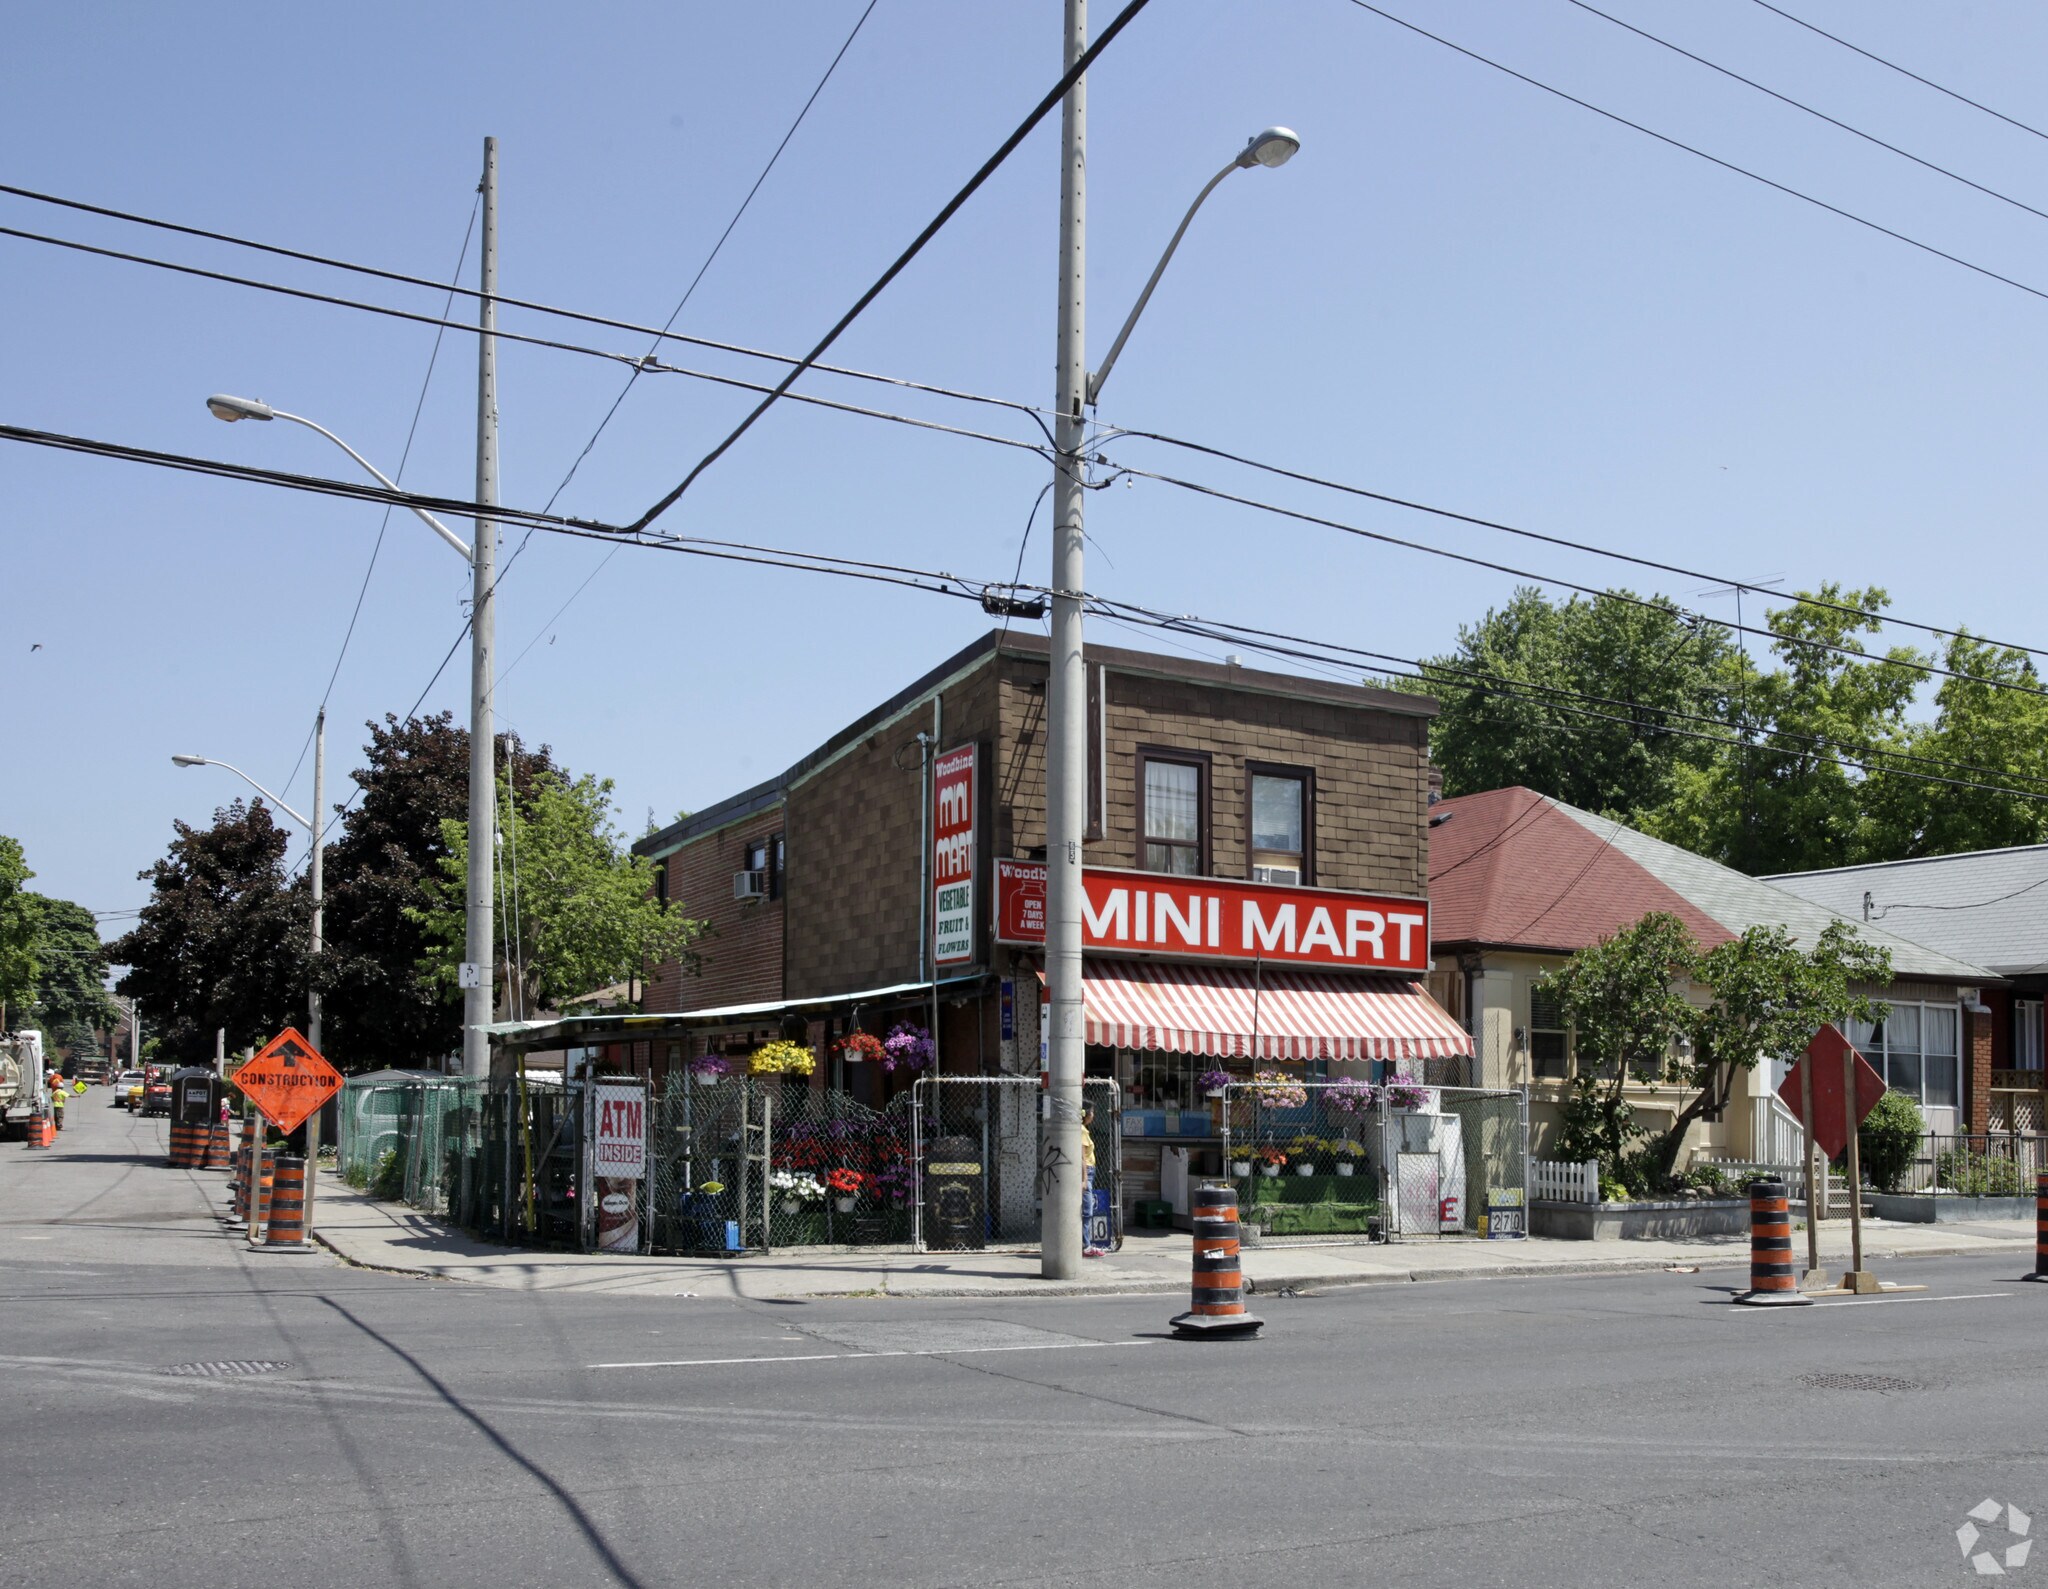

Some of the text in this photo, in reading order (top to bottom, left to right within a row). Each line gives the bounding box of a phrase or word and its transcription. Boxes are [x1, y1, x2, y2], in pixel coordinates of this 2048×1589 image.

[935, 754, 973, 778] Woodbine
[936, 829, 973, 879] MART
[938, 885, 969, 912] VEGETABLE
[1024, 899, 1042, 909] OPEN
[1022, 909, 1043, 920] 7 DAYS
[1080, 885, 1423, 961] MINI MART
[938, 917, 964, 935] FRUIT
[1020, 919, 1045, 930] A WEEK
[938, 939, 969, 955] FLOWERS
[241, 1072, 336, 1087] CONSTRUCTION
[600, 1100, 642, 1139] ATM
[600, 1144, 641, 1162] INSIDE
